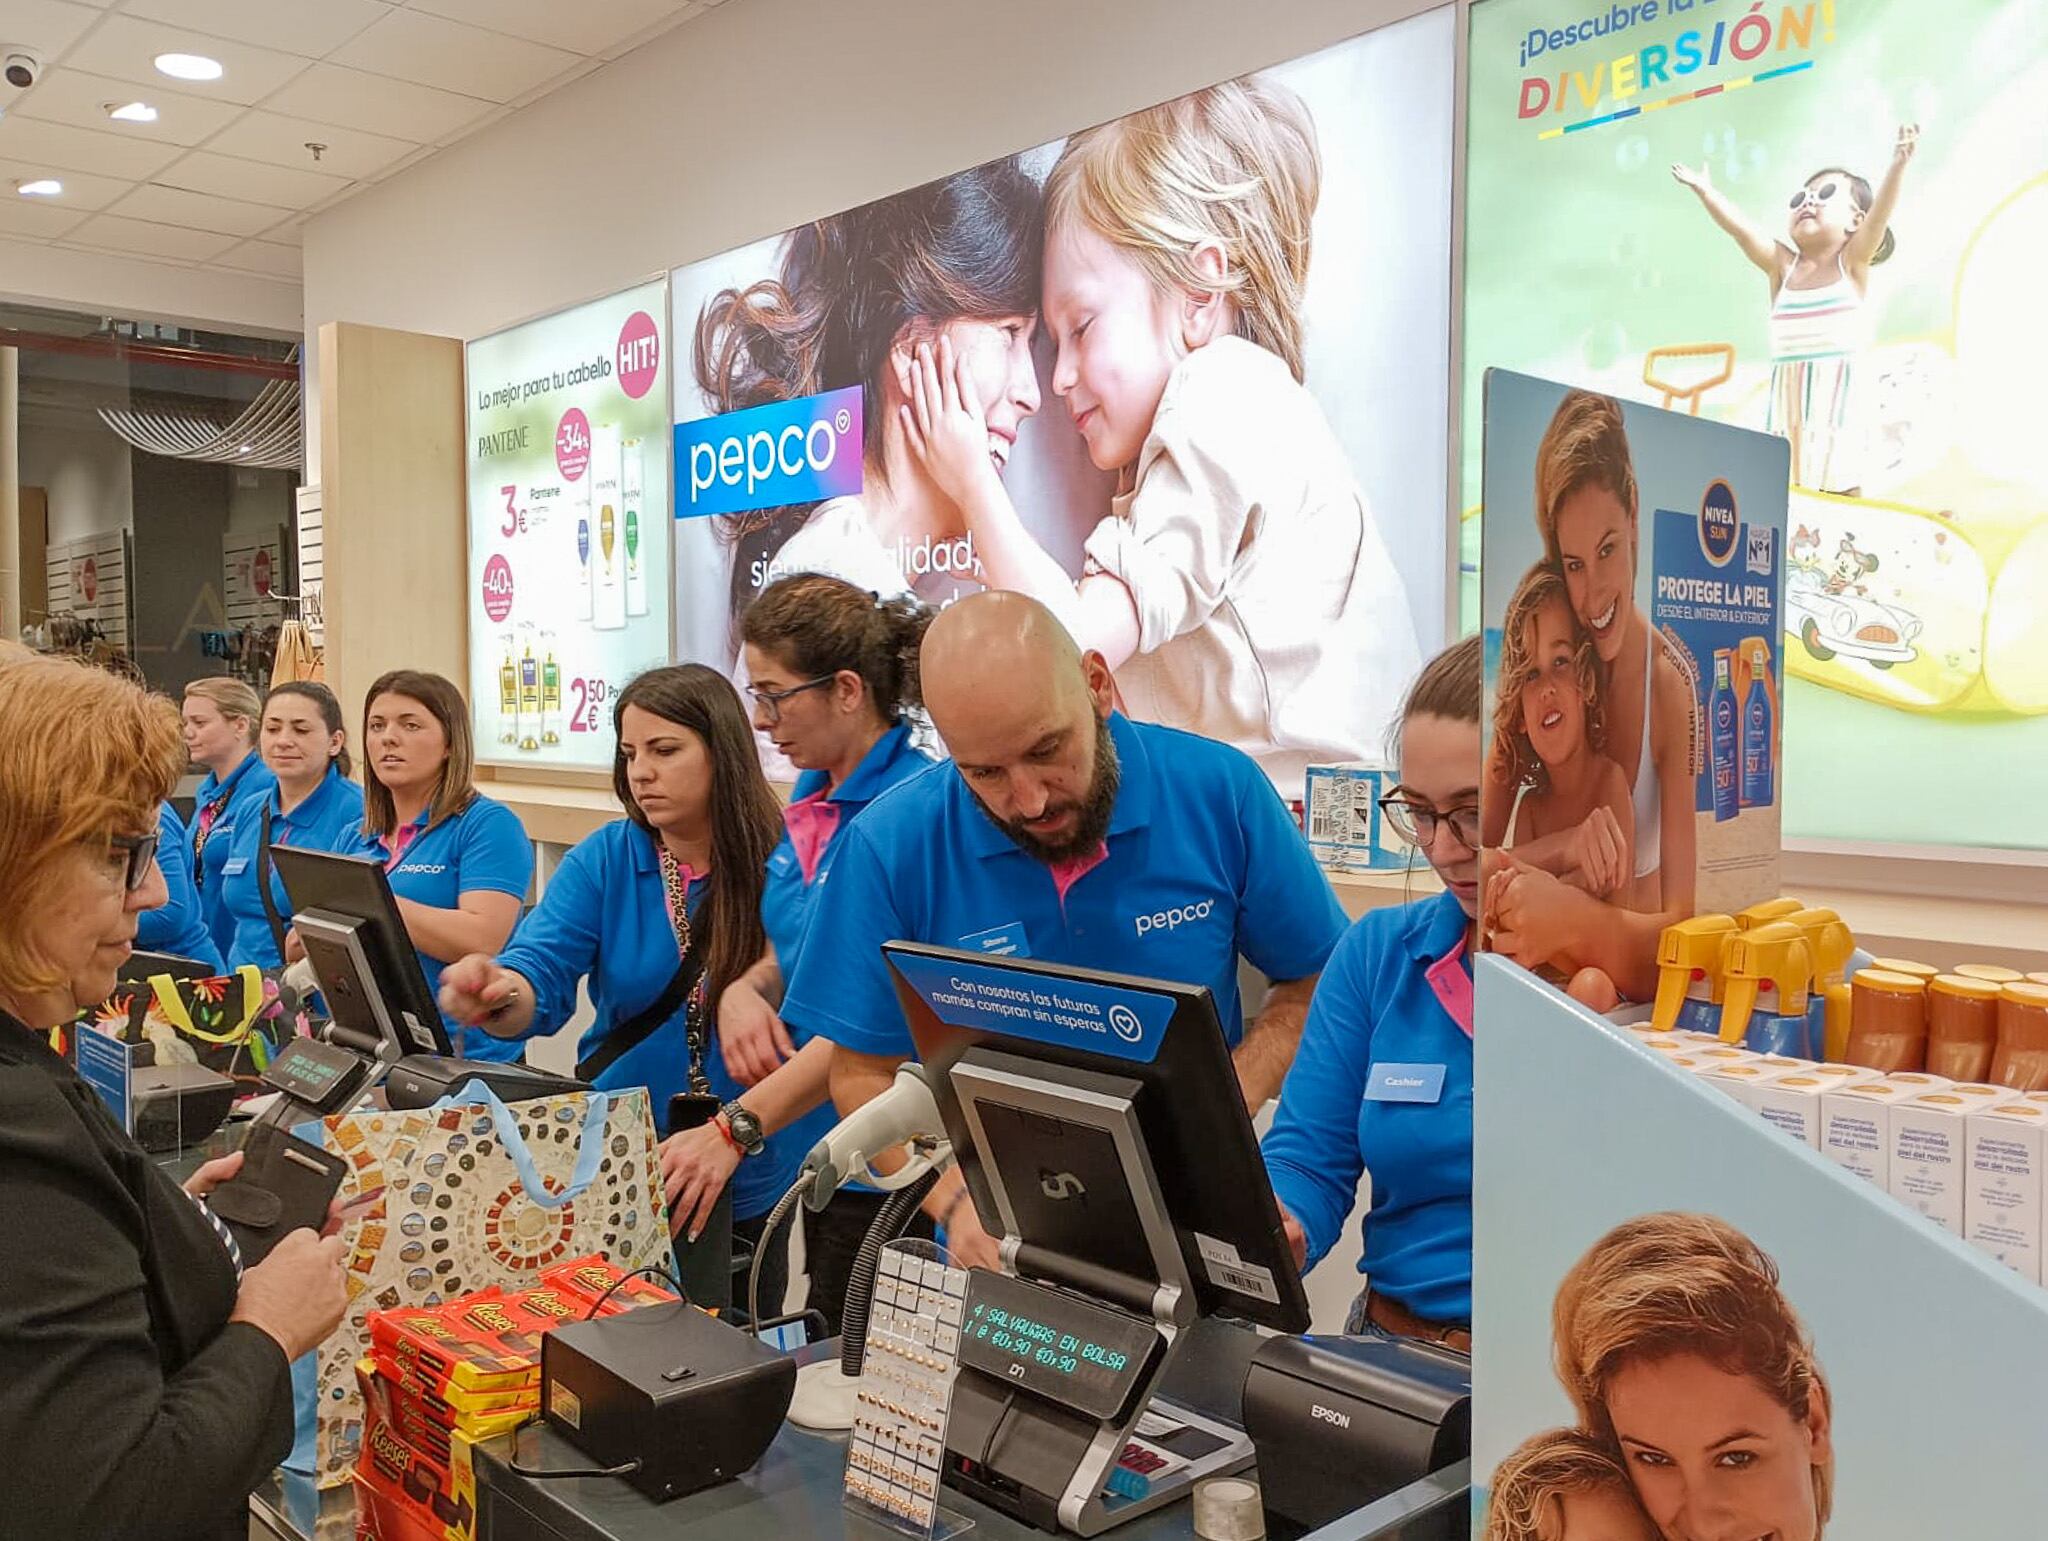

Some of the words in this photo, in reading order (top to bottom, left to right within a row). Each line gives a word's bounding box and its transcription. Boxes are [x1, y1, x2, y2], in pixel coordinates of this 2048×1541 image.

[1520, 0, 1659, 67] ¡Descubre
[1518, 0, 1836, 119] DIVERSIÓN!
[620, 335, 656, 375] HIT!
[478, 390, 491, 410] Lo
[493, 382, 522, 409] mejor
[523, 376, 550, 403] para
[552, 372, 565, 391] tu
[567, 355, 612, 386] cabello
[478, 425, 529, 457] PANTENE
[690, 418, 838, 503] pepco
[530, 487, 560, 500] Pantene
[1705, 506, 1735, 526] NIVEA
[1710, 525, 1728, 540] SUN
[1658, 576, 1722, 605] PROTEGE
[1725, 583, 1743, 606] LA
[1744, 585, 1771, 609] PIEL
[397, 864, 441, 875] pepco
[1135, 902, 1210, 937] pepco
[932, 991, 975, 1008] mamás
[977, 999, 1031, 1020] compran
[1033, 1008, 1052, 1022] sin
[1054, 1013, 1107, 1034] esperas
[951, 977, 976, 994] Con
[979, 983, 1029, 1003] nosotros
[1031, 990, 1050, 1006] las
[1053, 994, 1101, 1016] futuras
[1384, 1076, 1424, 1087] Cashier
[963, 1320, 973, 1333] 1
[991, 1330, 1032, 1355] €0,90
[1035, 1347, 1077, 1373] €0,90
[974, 1303, 985, 1317] 4
[1058, 1334, 1080, 1352] EN
[1081, 1343, 1126, 1371] BOLSA
[1311, 1405, 1350, 1429] EPSON
